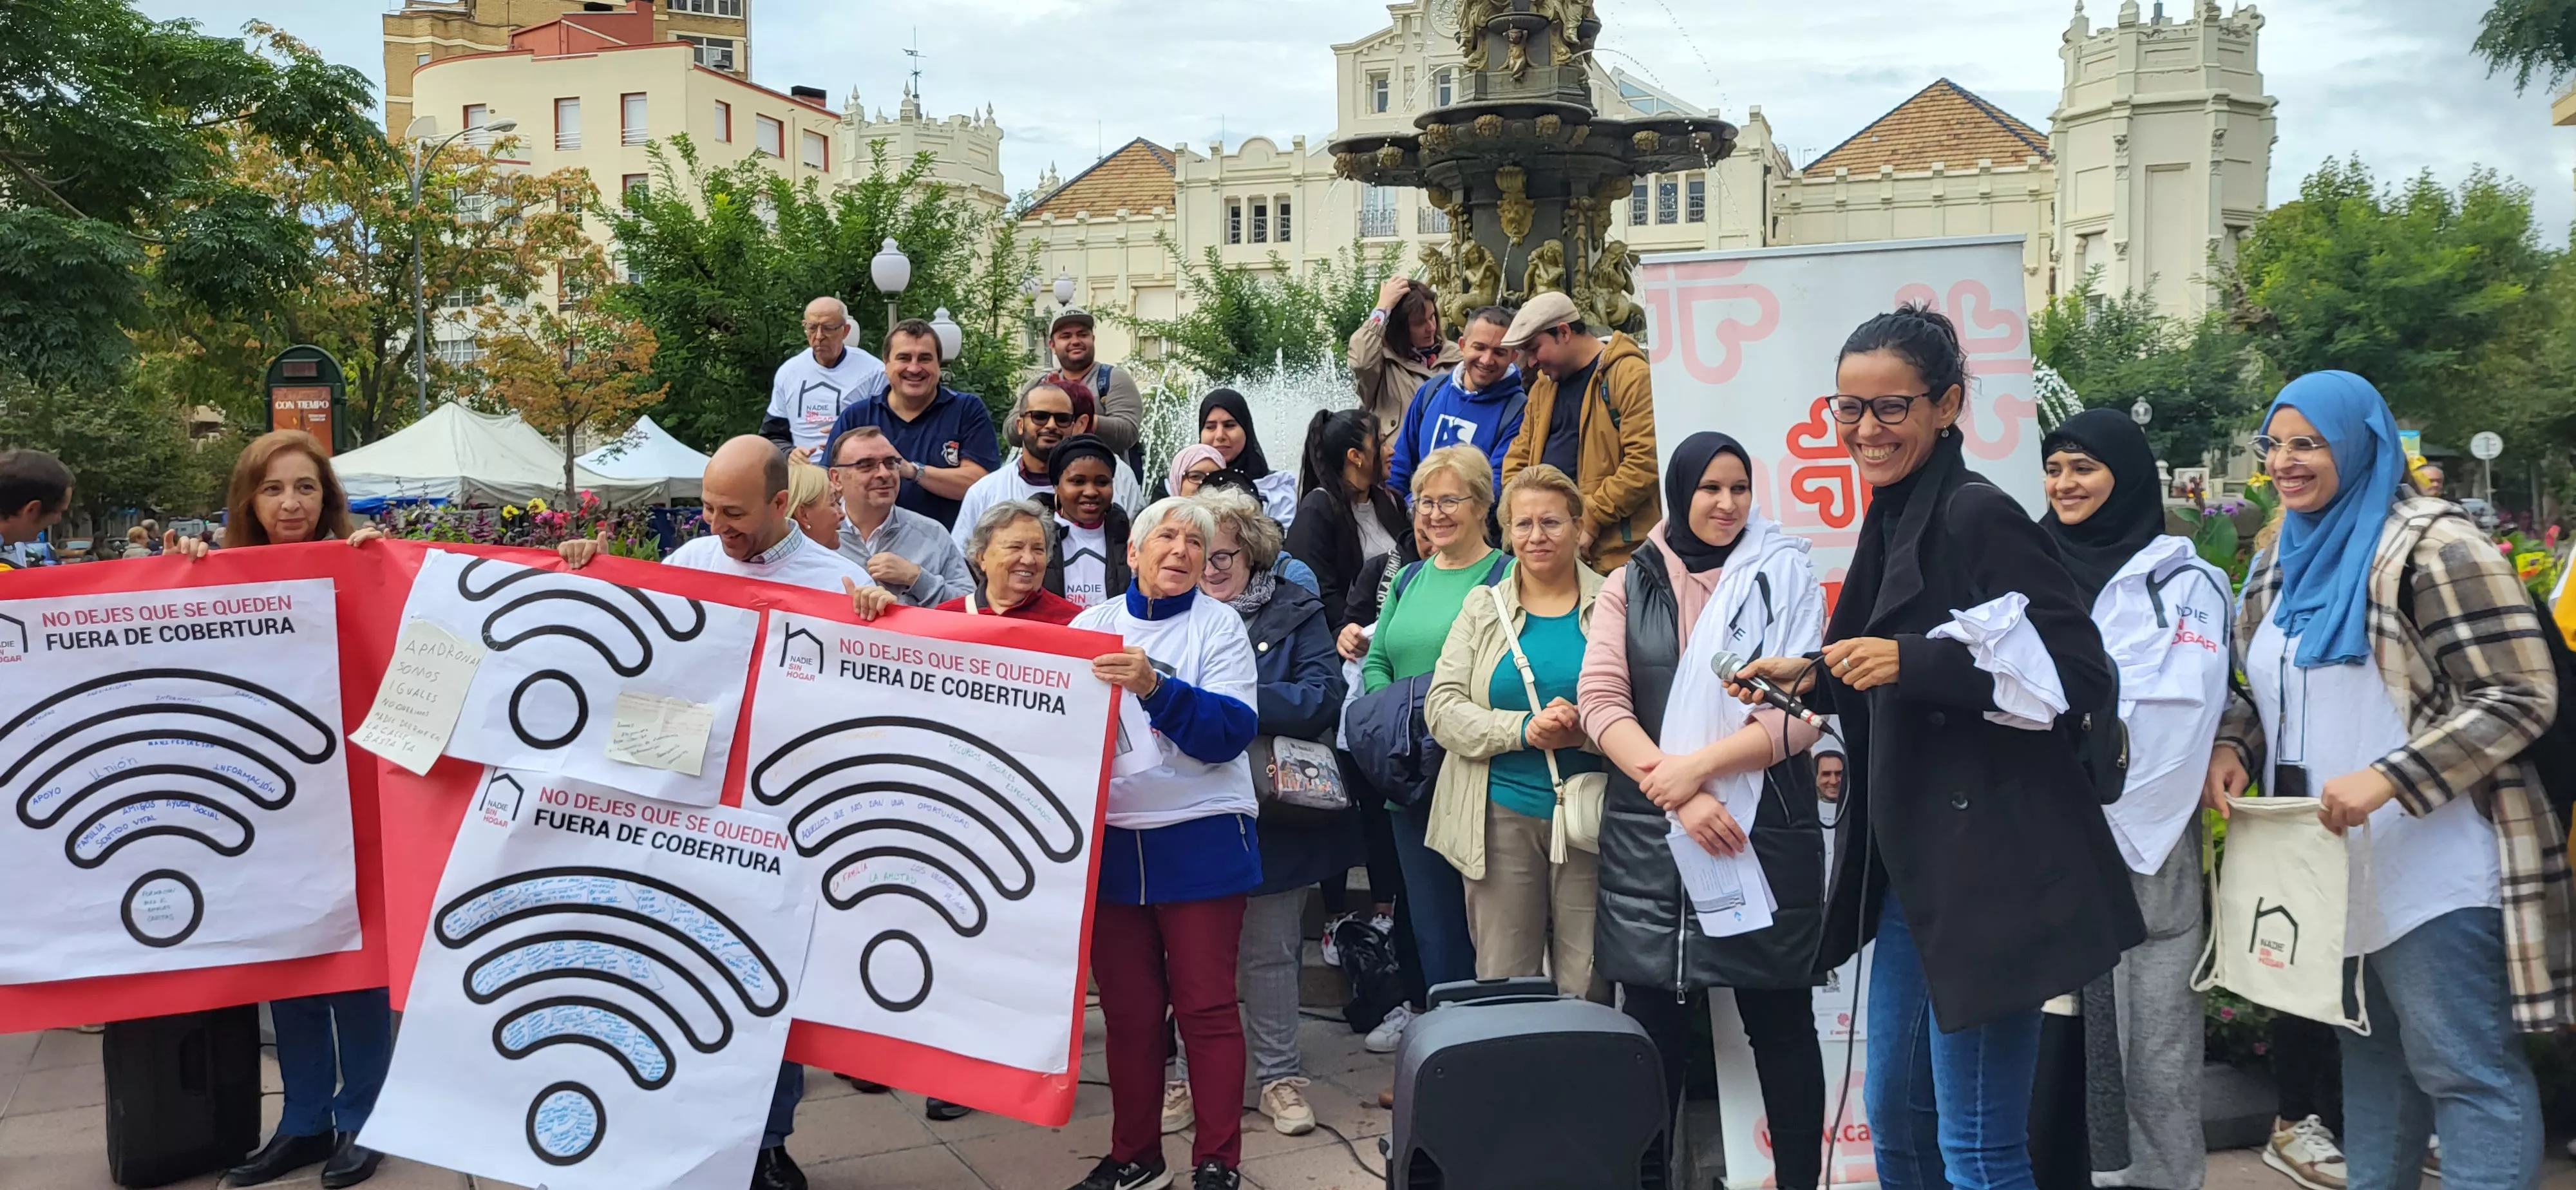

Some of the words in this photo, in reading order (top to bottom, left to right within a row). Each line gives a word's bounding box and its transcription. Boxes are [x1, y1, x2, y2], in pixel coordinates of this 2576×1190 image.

[275, 401, 295, 410] CON
[296, 401, 330, 410] TIEMPO
[1066, 584, 1102, 593] NADIE
[1066, 594, 1086, 603] SIN
[42, 611, 70, 627] NO
[75, 607, 134, 625] DEJES
[139, 604, 180, 622] QUE
[184, 601, 208, 618] SE
[213, 595, 292, 616] QUEDEN
[46, 629, 119, 651] FUERA
[124, 627, 153, 645] DE
[159, 617, 296, 643] COBERTURA
[790, 655, 813, 665] NADIE
[840, 638, 864, 656] NO
[869, 643, 923, 665] DEJES
[928, 652, 964, 672] QUE
[969, 658, 991, 676] SE
[996, 662, 1071, 690] QUEDEN
[396, 661, 440, 683] SOMOS
[786, 671, 815, 682] HOGAR
[840, 659, 904, 688] FUERA
[910, 671, 936, 693] DE
[942, 677, 1066, 715] COBERTURA
[382, 697, 394, 708] NO
[363, 732, 397, 748] BASTA
[402, 741, 417, 753] YA
[32, 787, 61, 805] APOYO
[488, 799, 509, 811] NADIE
[122, 800, 156, 815] AMIGOS
[166, 800, 191, 809] AYUDA
[193, 804, 219, 821] SOCIAL
[485, 807, 498, 817] SIN
[539, 786, 569, 806] NO
[574, 793, 636, 818] DEJES
[641, 806, 682, 827] QUE
[685, 815, 710, 833] SE
[714, 820, 789, 851] QUEDEN
[918, 802, 970, 829] OPORTUNIDAD
[95, 823, 129, 848] SENTIDO
[133, 815, 157, 826] VITAL
[483, 815, 508, 828] HOGAR
[75, 822, 108, 850] FAMILIA
[534, 808, 610, 839] FUERA
[616, 823, 647, 845] DE
[651, 831, 781, 876] COBERTURA
[869, 874, 878, 883] LA
[884, 872, 917, 885] AMISTAD
